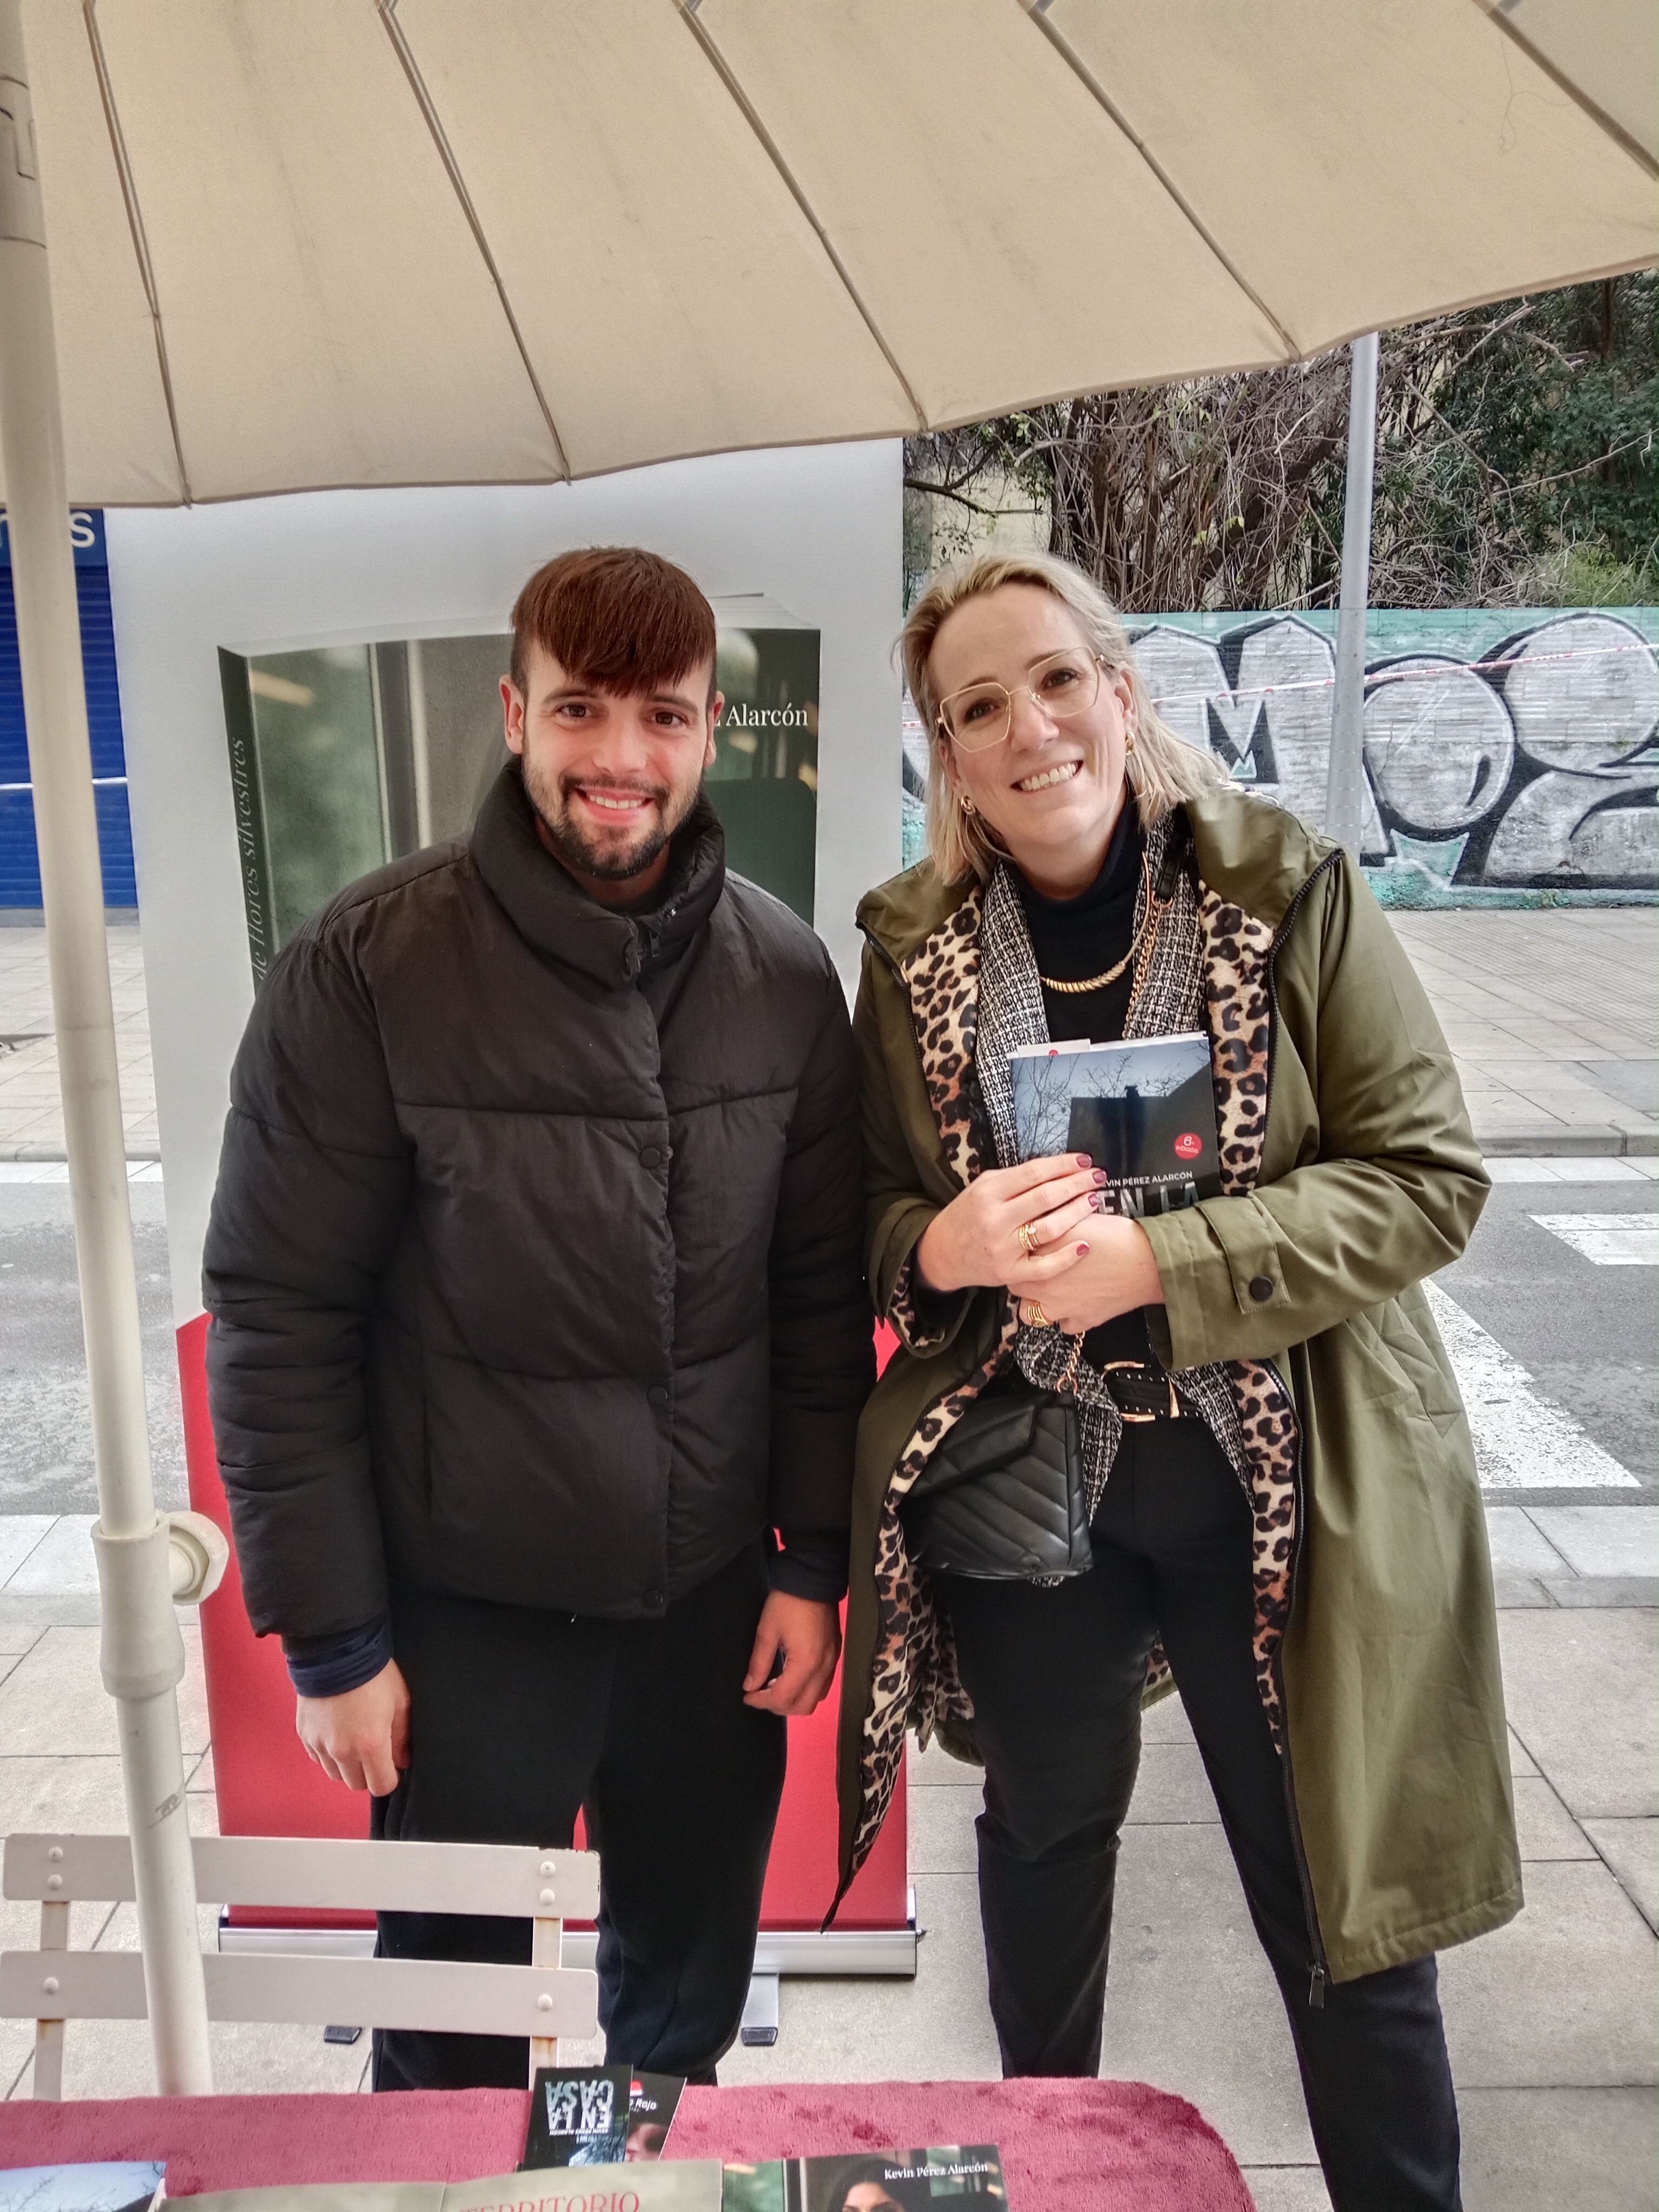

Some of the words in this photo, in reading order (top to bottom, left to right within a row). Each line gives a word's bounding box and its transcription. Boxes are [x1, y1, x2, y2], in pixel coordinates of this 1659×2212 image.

[725, 702, 808, 726] Alarcón
[233, 737, 256, 860] silvestres
[246, 866, 265, 947] flores
[1102, 1179, 1121, 1187] VIN
[1123, 1176, 1149, 1186] PÉREZ
[1152, 1171, 1192, 1184] ALARCÓN
[1097, 1186, 1145, 1218] EN
[544, 2080, 614, 2112] CASA
[635, 2098, 657, 2112] Rojo
[548, 2107, 573, 2130] LA
[580, 2106, 610, 2129] EN
[885, 2167, 914, 2179] Kevin
[917, 2165, 946, 2177] Pérez
[949, 2161, 988, 2175] Alarcón
